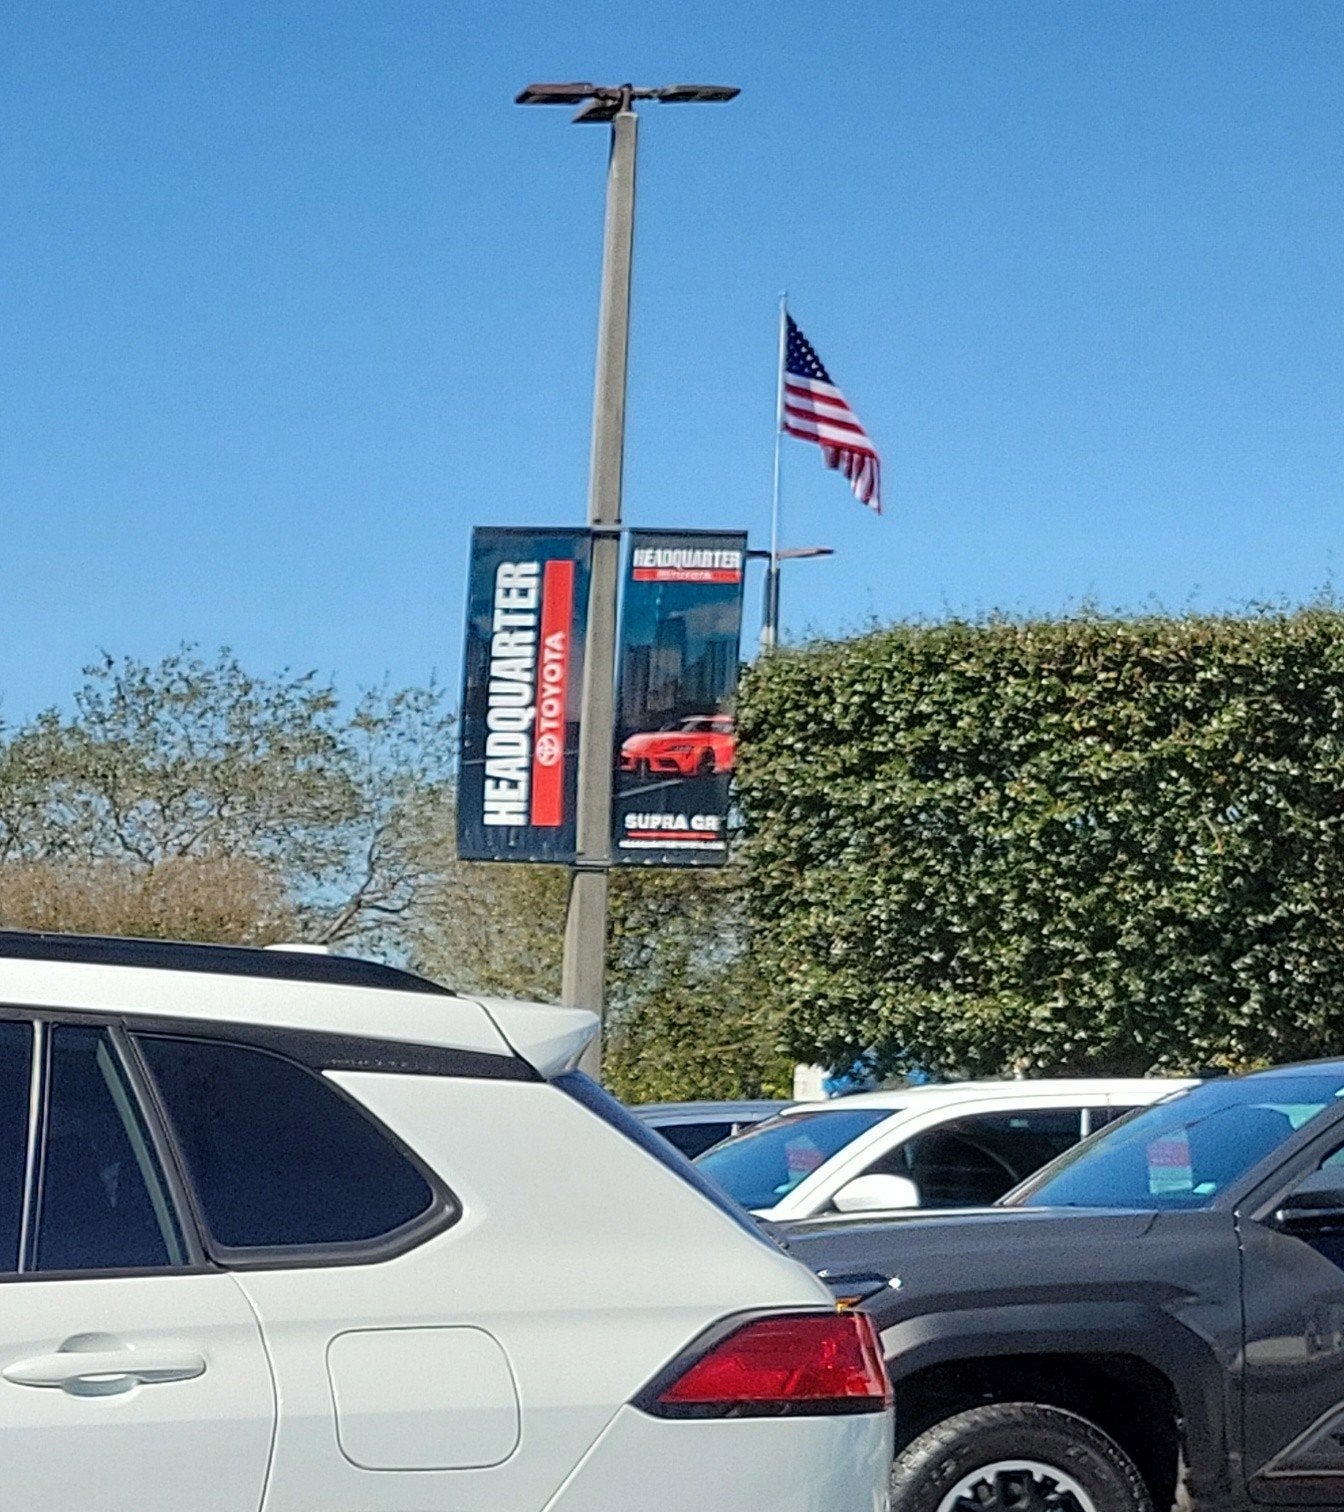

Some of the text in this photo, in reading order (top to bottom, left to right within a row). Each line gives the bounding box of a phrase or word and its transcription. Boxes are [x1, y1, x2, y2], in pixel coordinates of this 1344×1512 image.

[633, 548, 741, 569] HEADQUARTER
[483, 561, 540, 826] HEADQUARTER
[540, 631, 565, 733] TOYOTA
[624, 813, 689, 829] SUPRA
